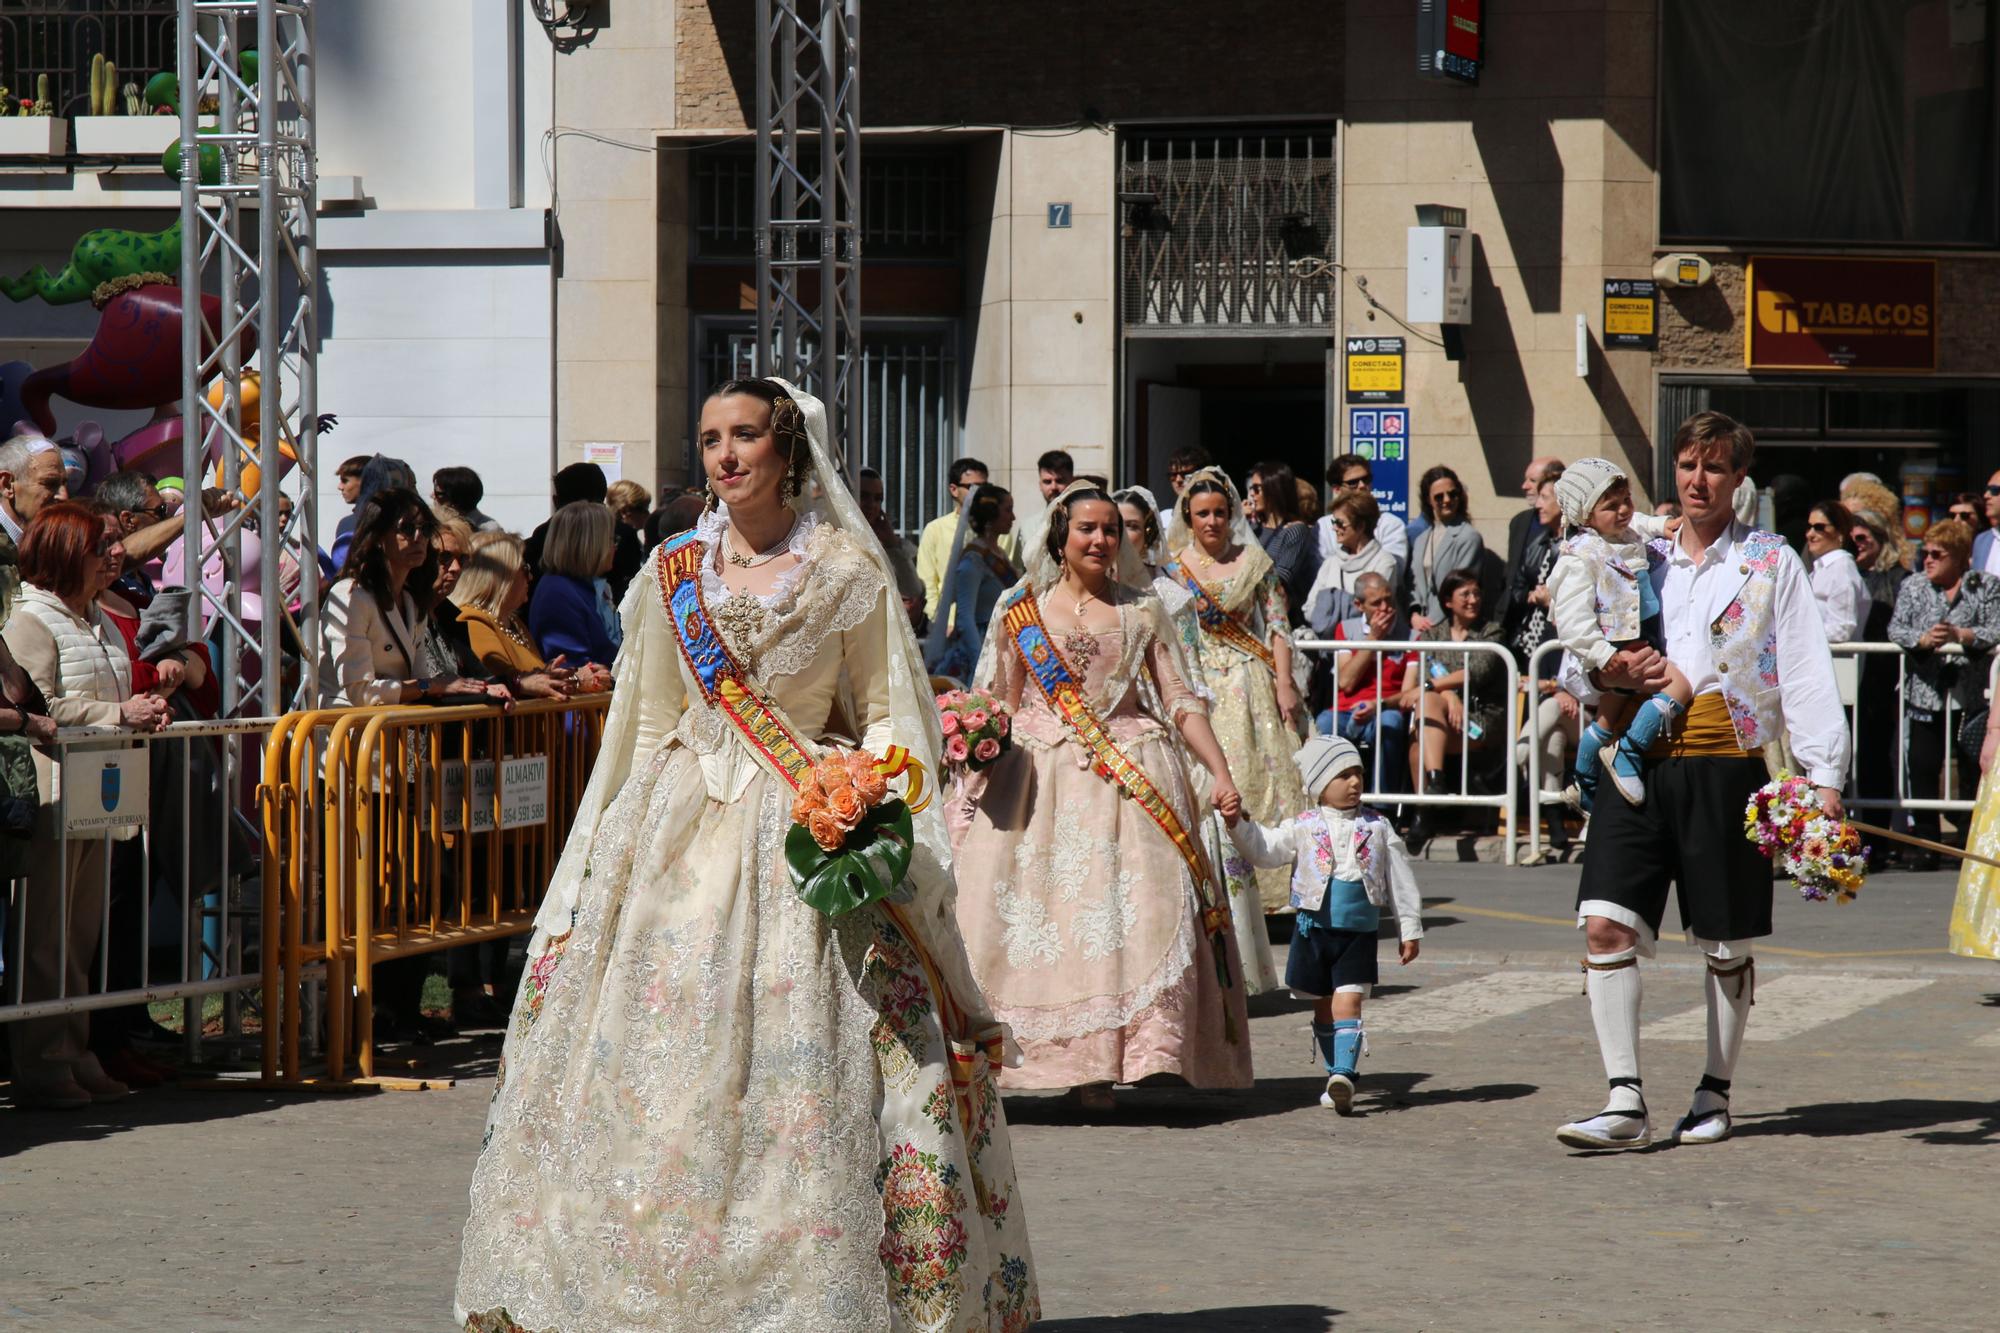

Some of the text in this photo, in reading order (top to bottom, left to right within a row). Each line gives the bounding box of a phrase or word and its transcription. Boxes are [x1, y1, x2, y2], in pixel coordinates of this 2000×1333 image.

[1054, 205, 1064, 226] 7
[1802, 301, 1929, 326] TABACOS
[504, 761, 545, 785] ALMAKIVI
[503, 808, 517, 823] 964
[518, 806, 530, 821] 591
[531, 803, 545, 819] 588
